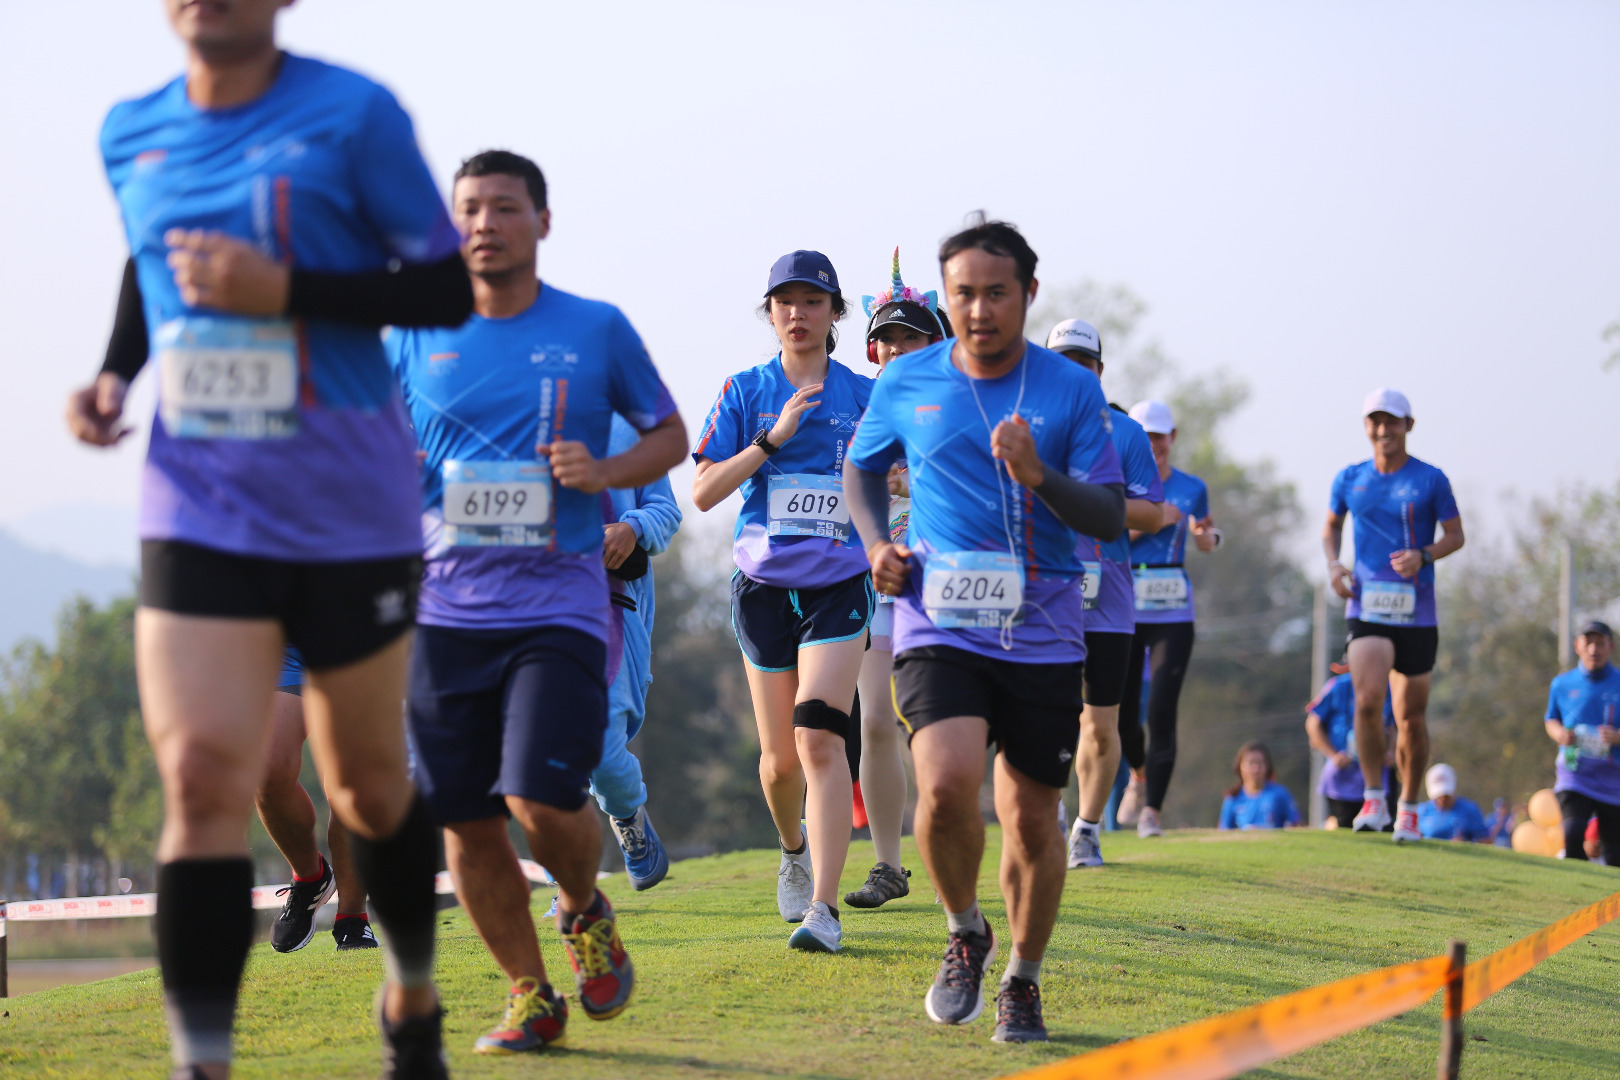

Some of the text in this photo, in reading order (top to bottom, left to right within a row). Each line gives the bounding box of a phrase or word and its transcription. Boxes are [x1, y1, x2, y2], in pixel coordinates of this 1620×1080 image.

[182, 361, 272, 396] 6253
[834, 439, 843, 470] CROSS
[464, 489, 528, 516] 6199
[787, 493, 839, 515] 6019
[834, 528, 843, 540] 16
[941, 576, 1005, 601] 6204
